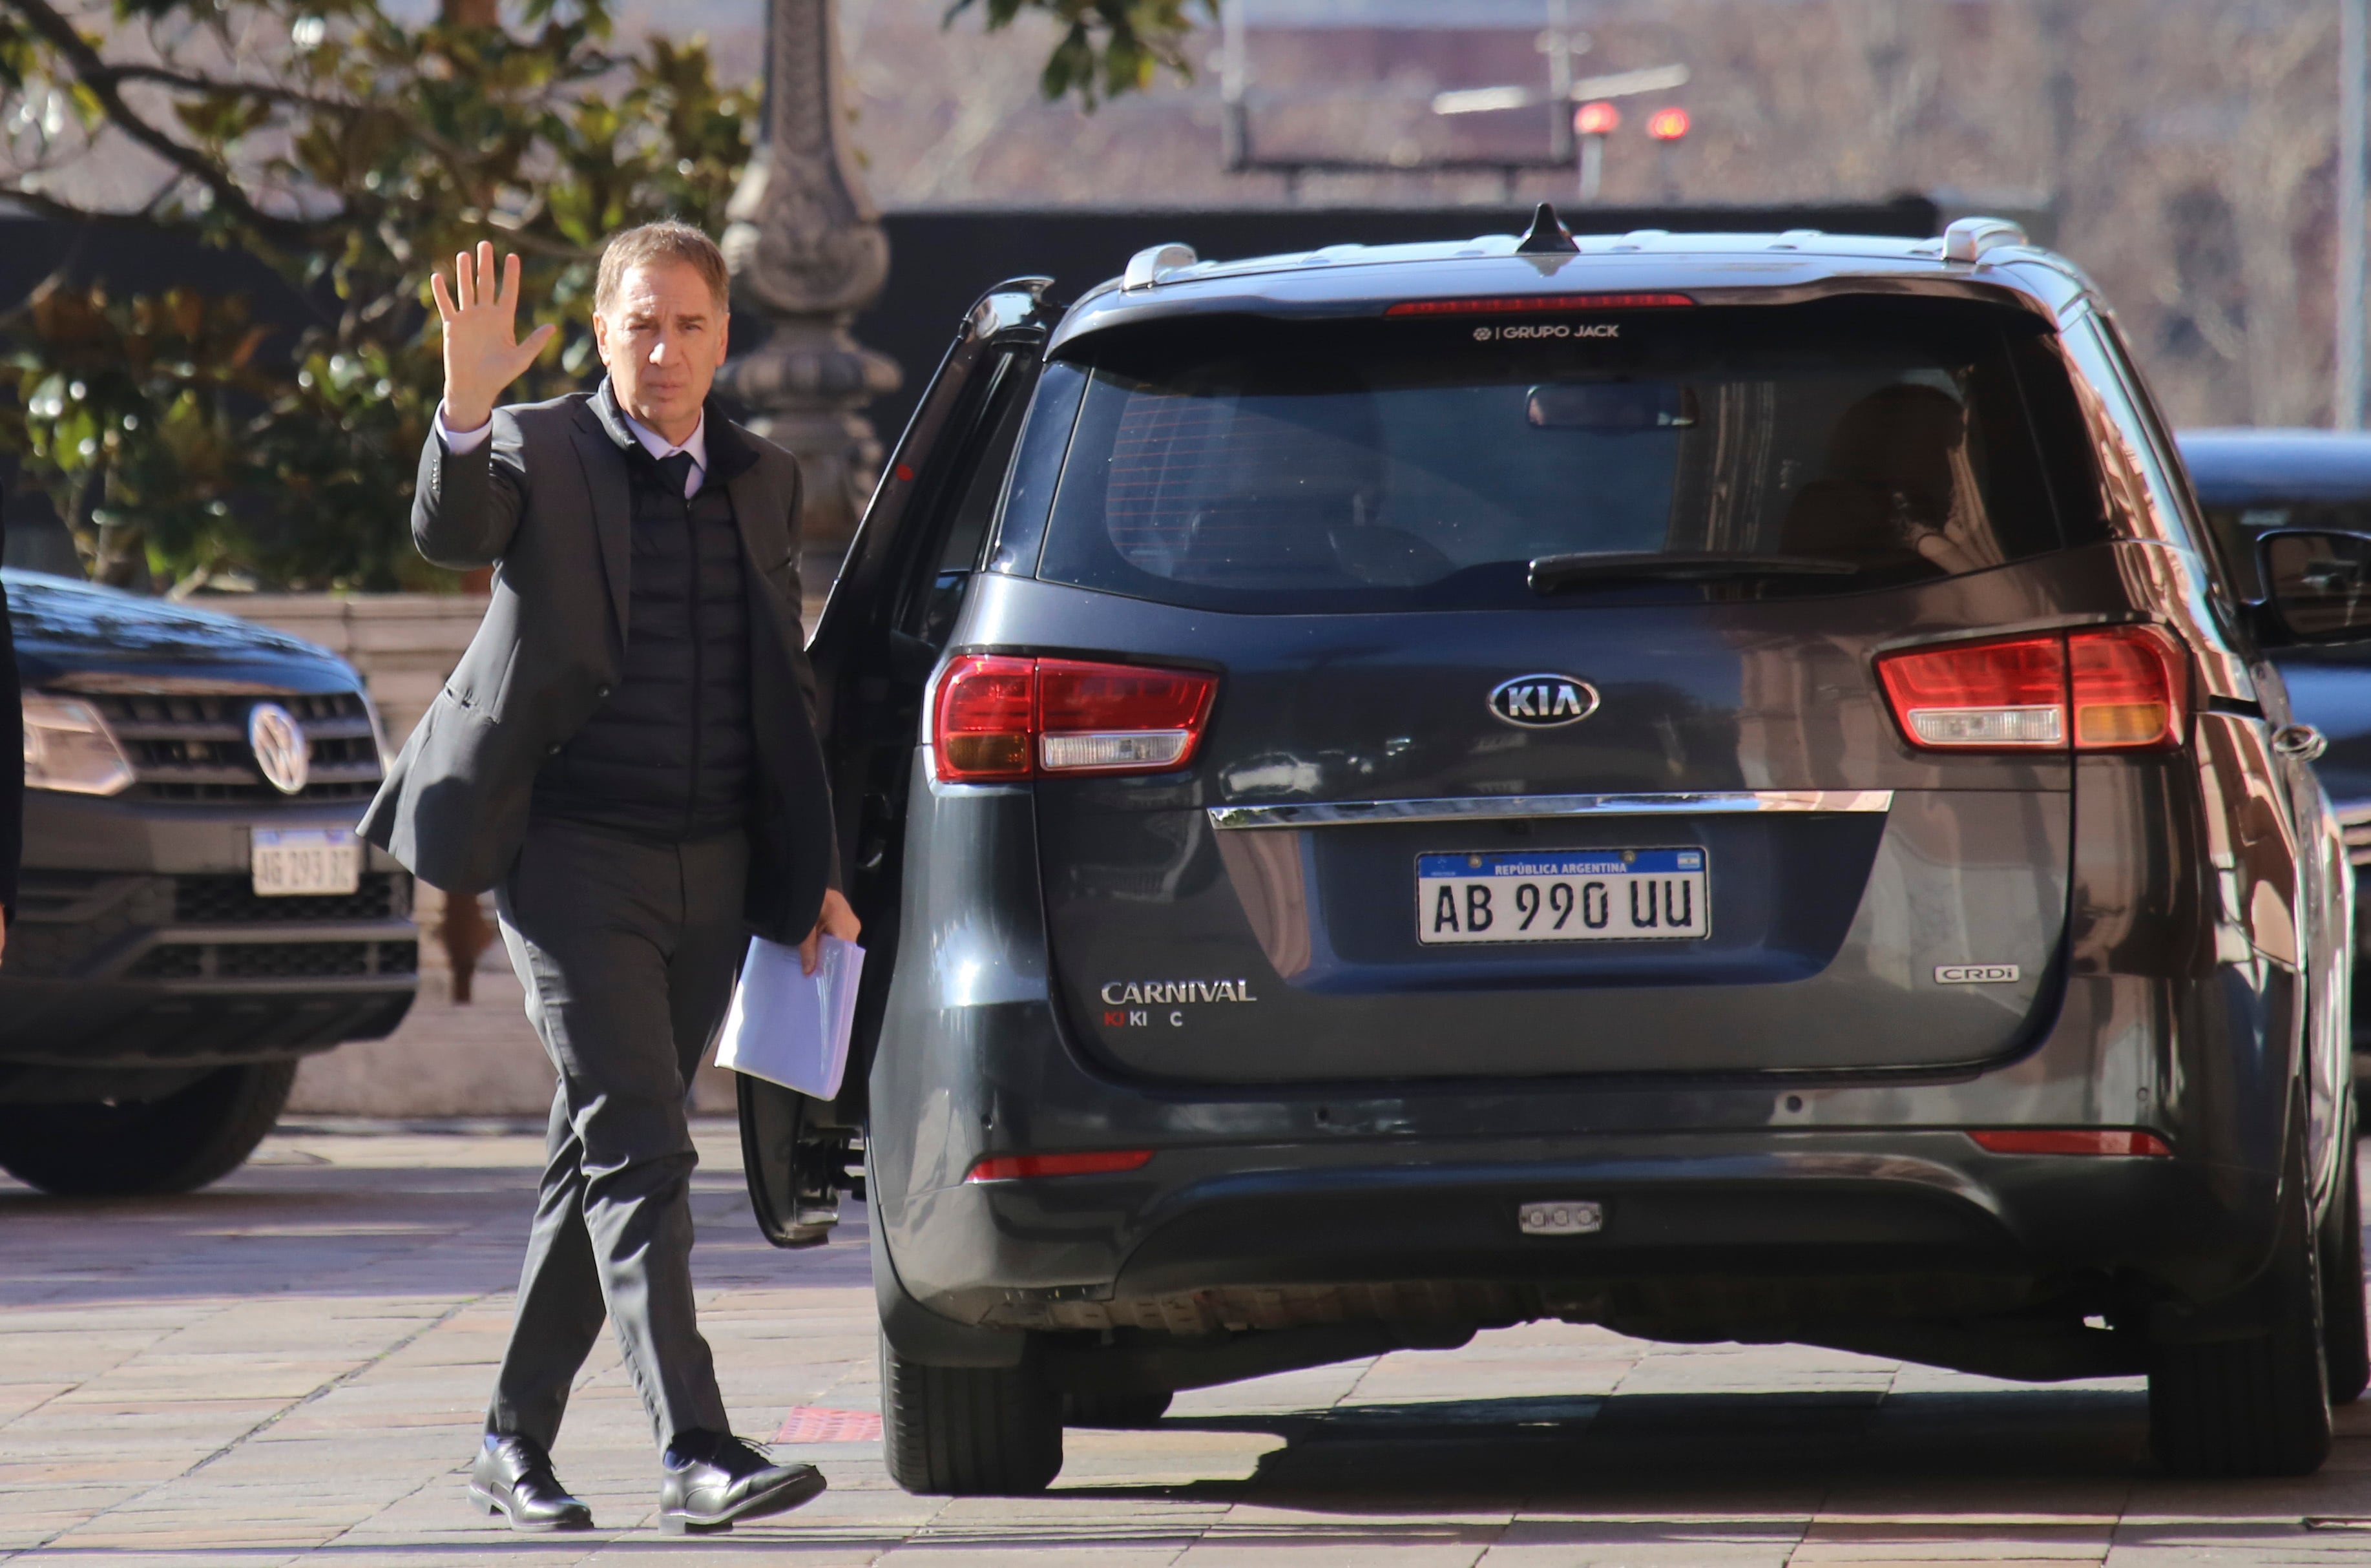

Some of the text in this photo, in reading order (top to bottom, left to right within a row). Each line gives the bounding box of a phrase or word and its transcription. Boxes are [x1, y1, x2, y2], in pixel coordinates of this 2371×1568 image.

[1503, 324, 1620, 339] GRUPO JACK
[1507, 685, 1582, 716] KIA
[1494, 862, 1627, 876] REPÚBLICA ARGENTINA
[1434, 880, 1693, 933] AB 990 UU
[1101, 979, 1257, 1005] CARNIVAL
